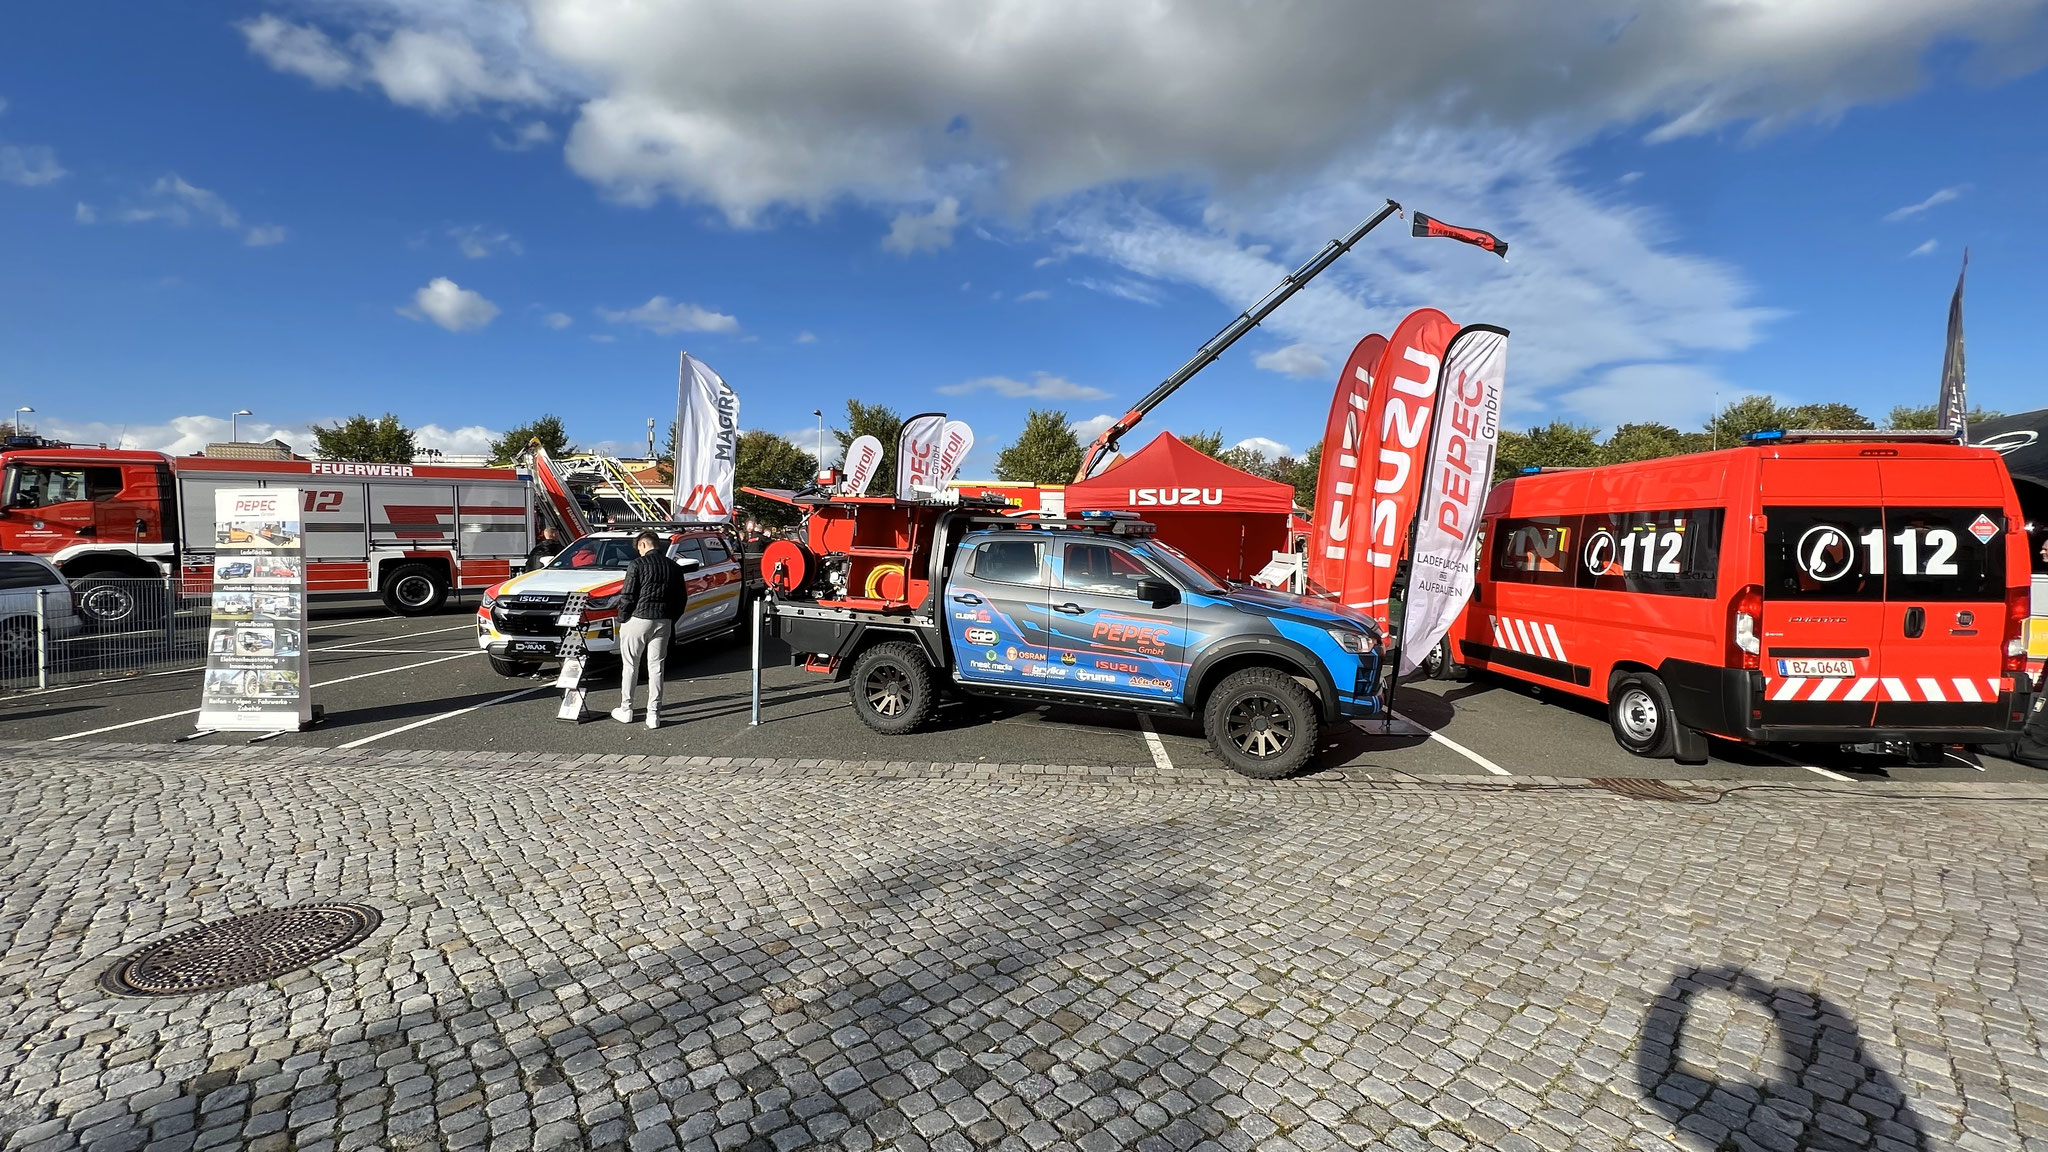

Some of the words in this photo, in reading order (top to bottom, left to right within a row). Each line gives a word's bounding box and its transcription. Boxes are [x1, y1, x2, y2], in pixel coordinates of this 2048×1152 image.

[1482, 384, 1499, 441] GmbH
[932, 444, 940, 475] GmbH
[1367, 346, 1440, 567] ISUZU
[1438, 369, 1483, 541] PEPEC
[311, 463, 414, 477] FEUERWEHR
[849, 445, 874, 494] logiroll
[235, 500, 276, 511] PEPEC
[1128, 488, 1223, 506] ISUZU
[1620, 532, 1683, 573] 112
[1861, 528, 1959, 575] 112
[1092, 622, 1170, 647] PEPEC
[1018, 651, 1047, 661] OSRAM
[1138, 646, 1166, 656] GmbH
[1094, 660, 1139, 674] ISUZU
[1792, 661, 1810, 674] BZ
[1817, 661, 1848, 674] 0648
